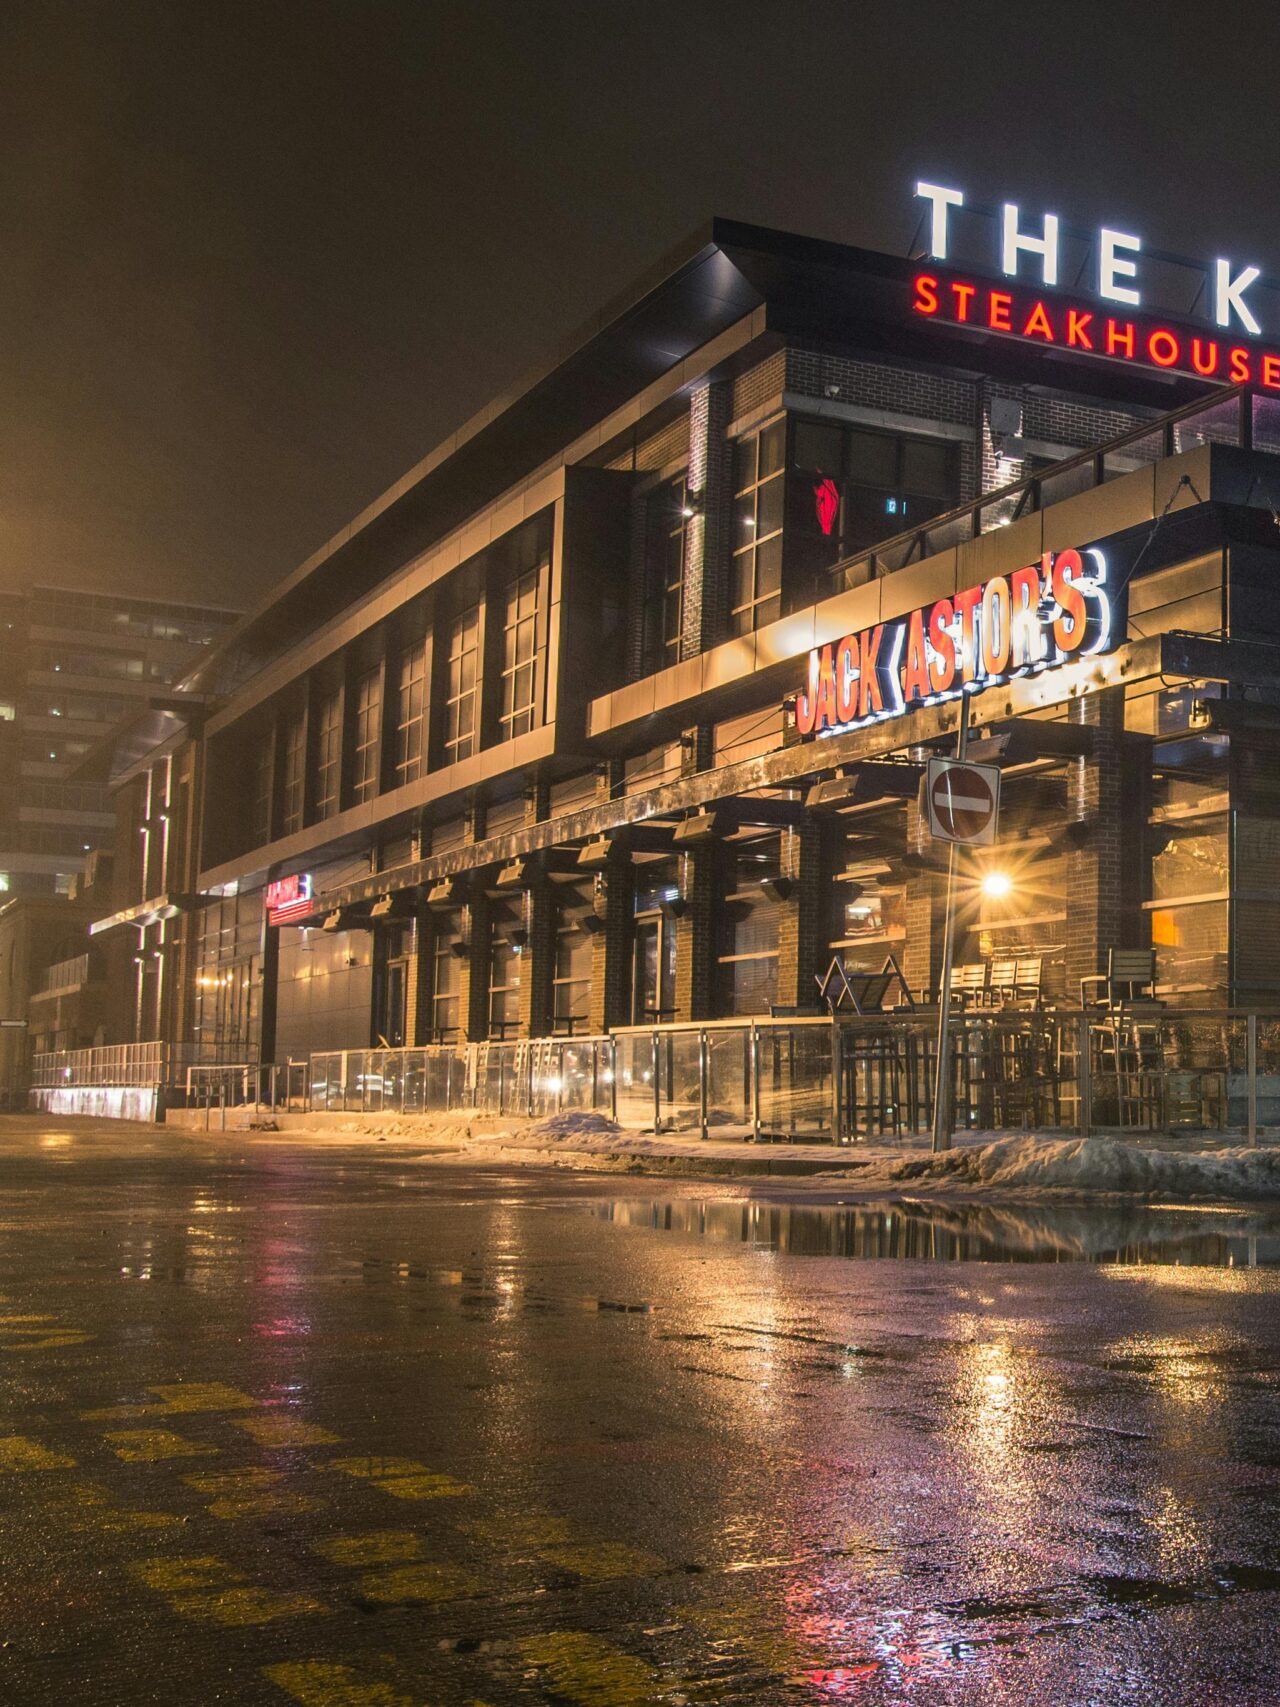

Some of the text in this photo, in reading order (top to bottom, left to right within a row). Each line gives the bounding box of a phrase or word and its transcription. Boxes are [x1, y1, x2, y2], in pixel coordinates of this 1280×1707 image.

[917, 182, 1141, 305] THE
[796, 548, 1088, 735] JACK ASTOR'S
